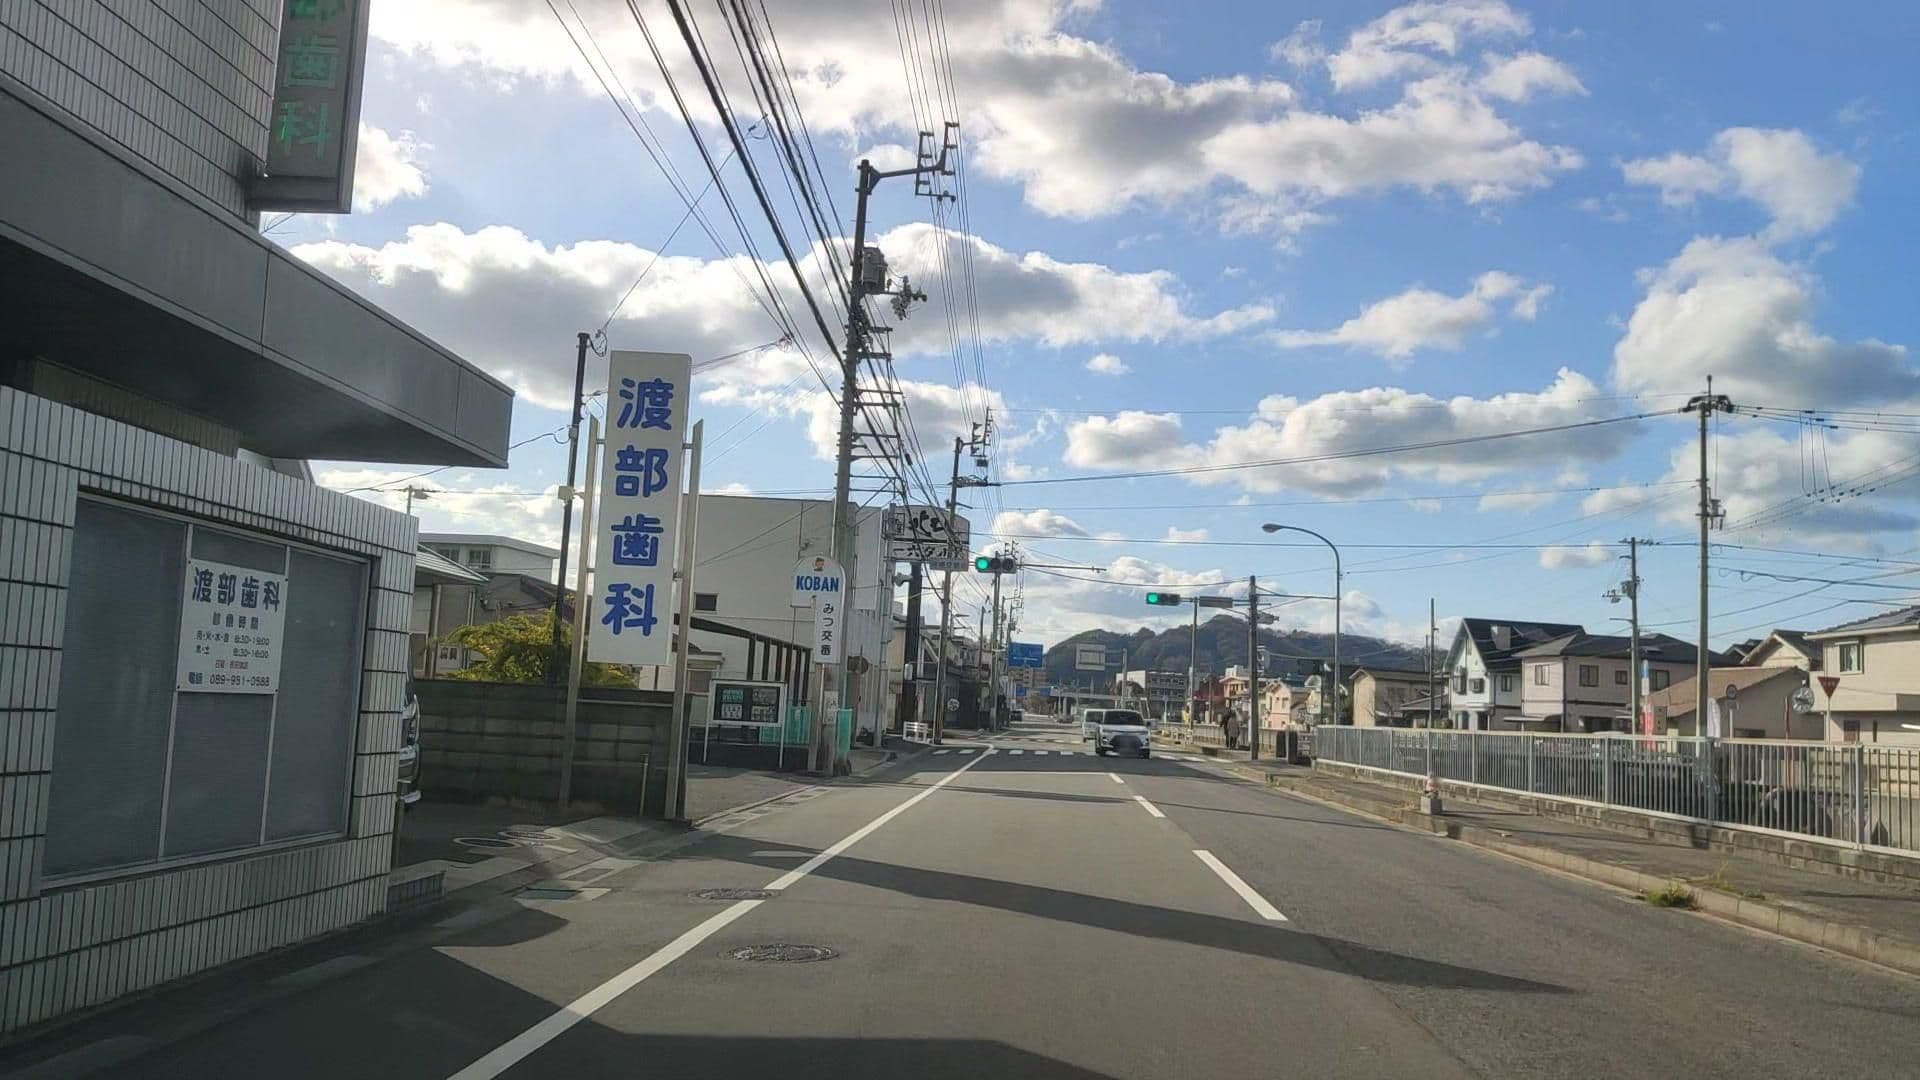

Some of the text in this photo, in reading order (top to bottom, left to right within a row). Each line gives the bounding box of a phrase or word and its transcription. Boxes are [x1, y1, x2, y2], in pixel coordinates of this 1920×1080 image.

[602, 378, 675, 636] 渡部歯科
[192, 567, 281, 613] 渡部歯科
[796, 575, 840, 592] KOBAN
[820, 603, 834, 656] みつ交番
